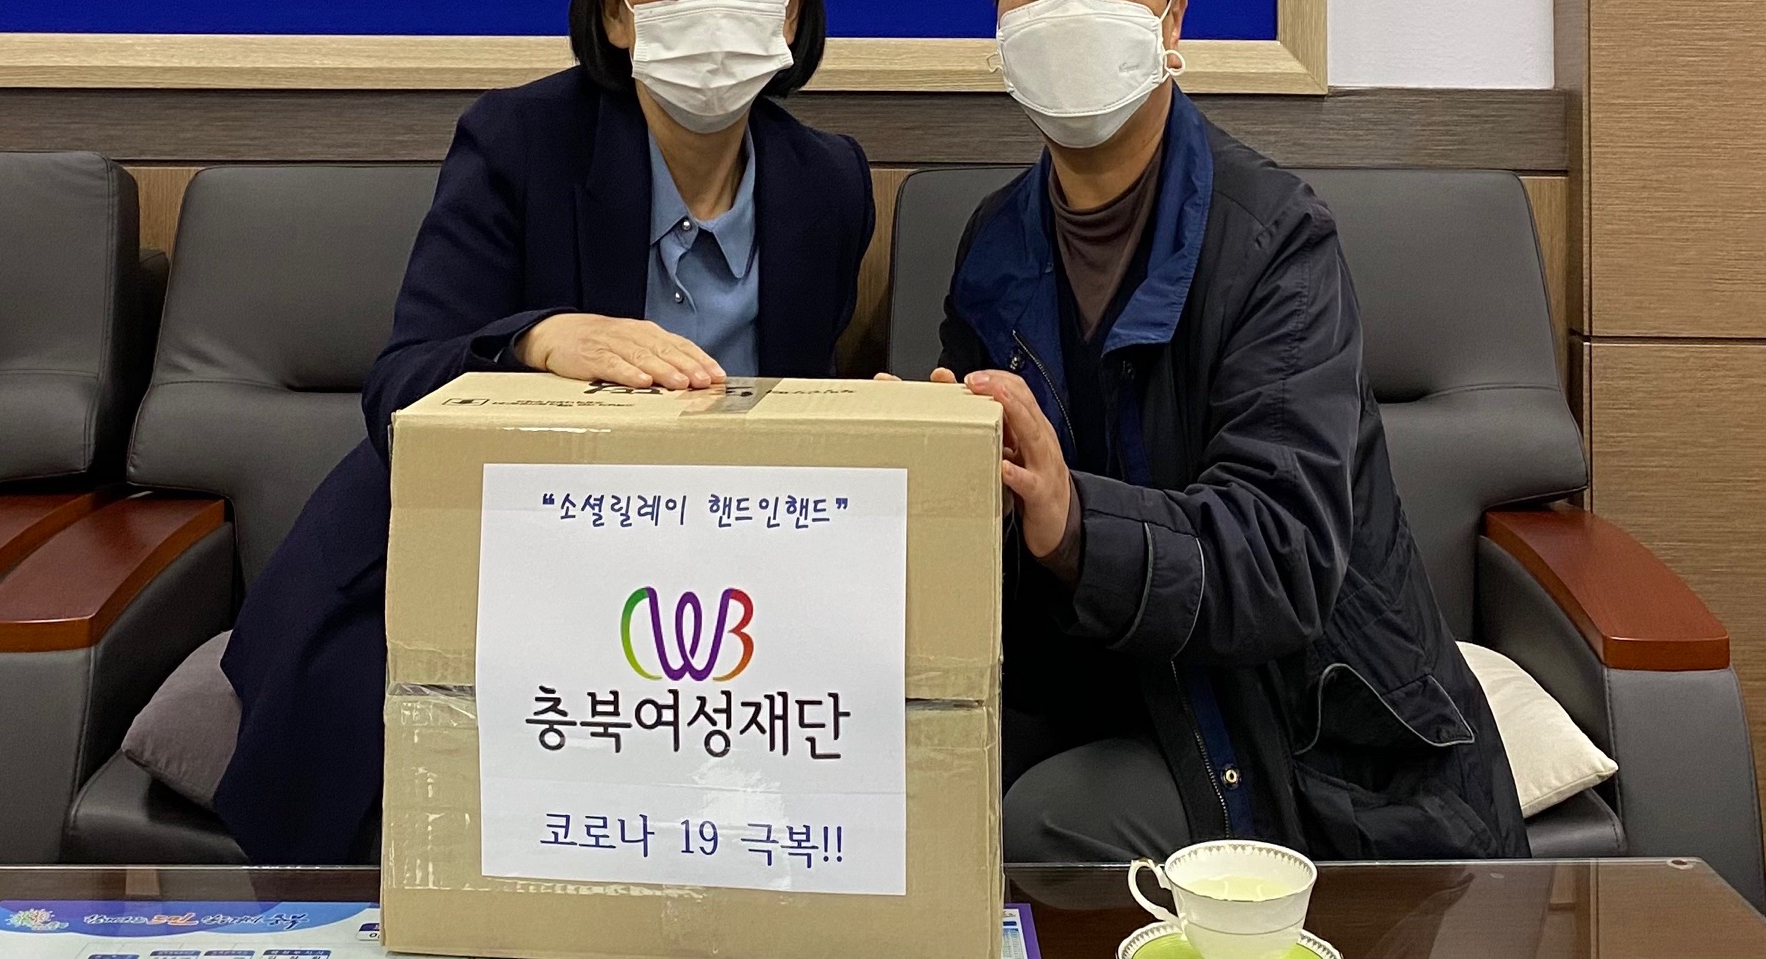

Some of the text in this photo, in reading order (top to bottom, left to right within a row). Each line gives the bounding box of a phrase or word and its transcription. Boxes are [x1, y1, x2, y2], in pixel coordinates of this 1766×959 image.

[524, 685, 852, 760] 충북여성재단
[539, 813, 843, 868] 코로나 19 극복!!
